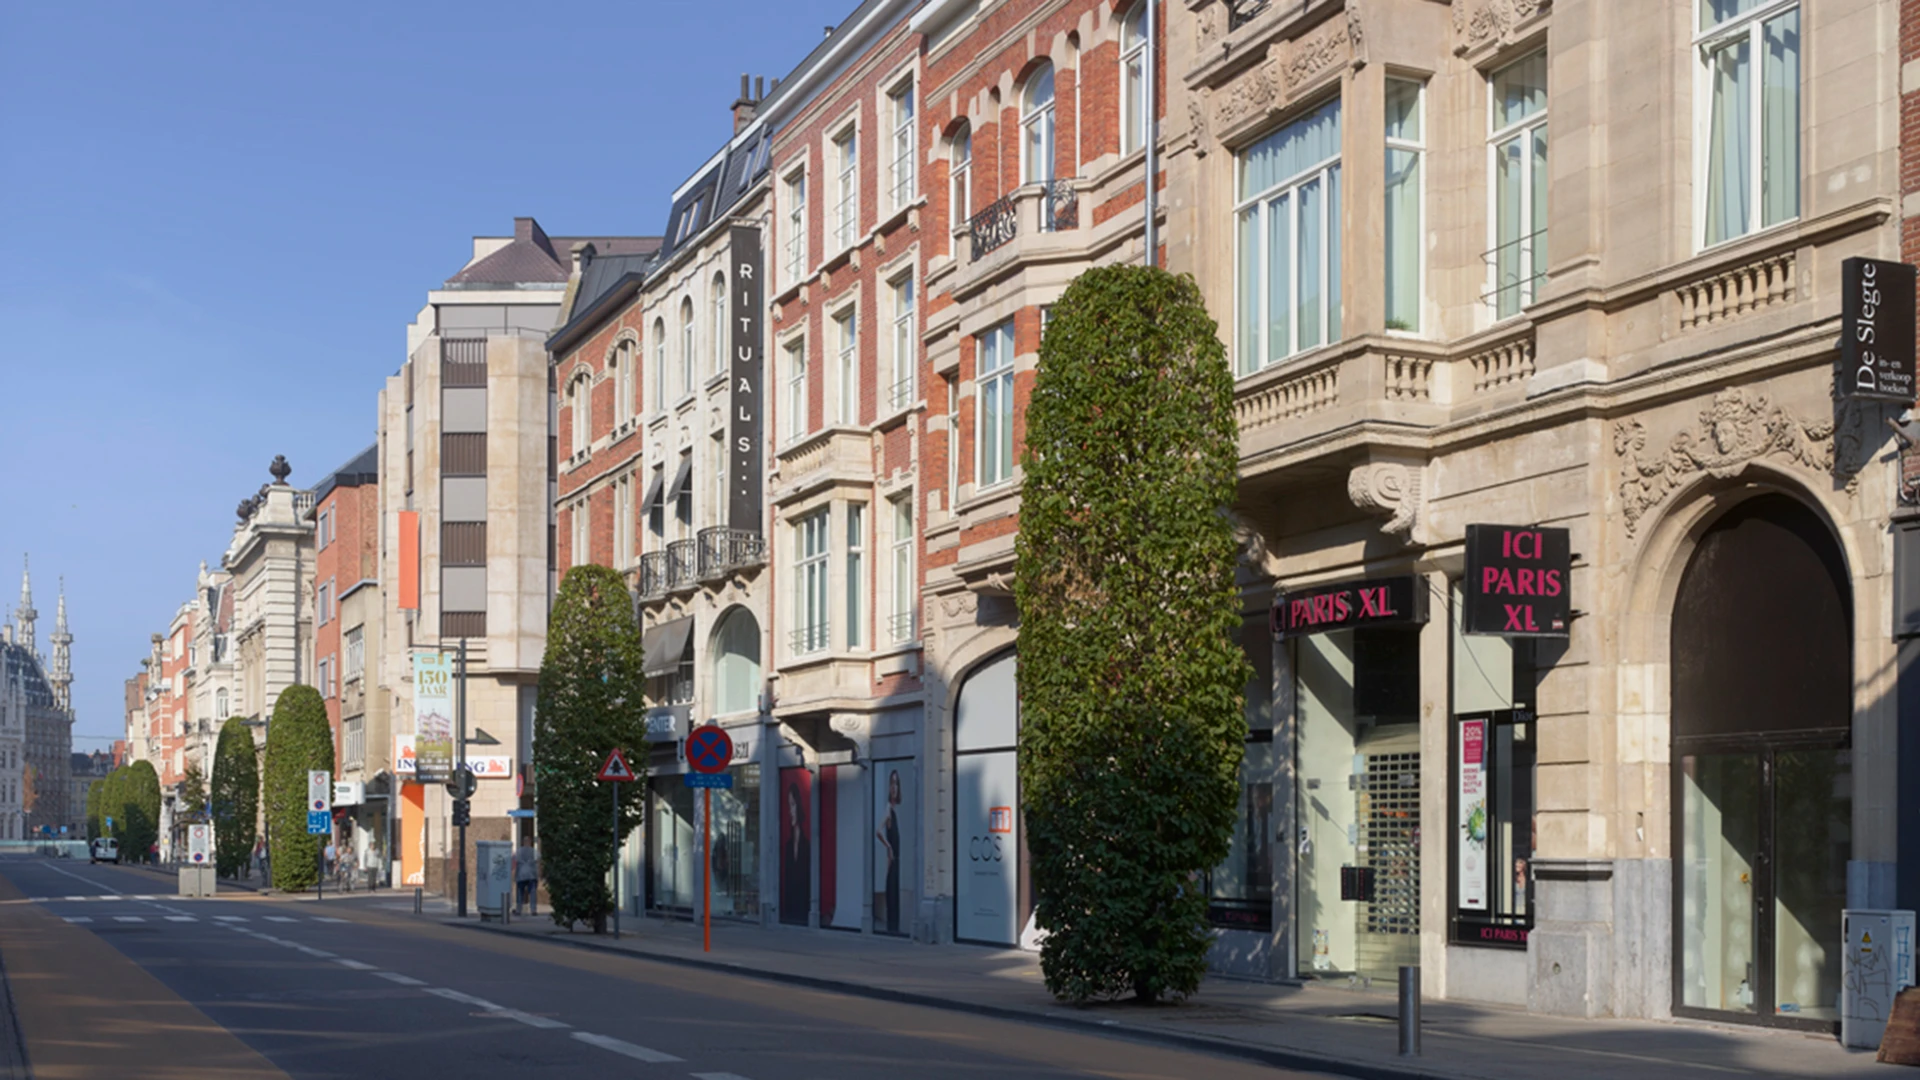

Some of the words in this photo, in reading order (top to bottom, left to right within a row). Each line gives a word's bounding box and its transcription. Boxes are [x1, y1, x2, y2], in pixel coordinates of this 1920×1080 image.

[1857, 263, 1881, 343] Slegte
[1857, 351, 1876, 389] De
[1879, 370, 1912, 385] verkoop
[1879, 381, 1909, 394] boeken
[1502, 531, 1542, 559] ICI
[1482, 566, 1561, 597] PARIS
[1291, 591, 1350, 629] PARIS
[1358, 586, 1395, 618] XL
[1503, 604, 1540, 632] XL
[397, 759, 416, 769] IN
[970, 836, 1002, 861] COS
[1481, 928, 1492, 939] ICI
[1495, 928, 1518, 941] PARIS
